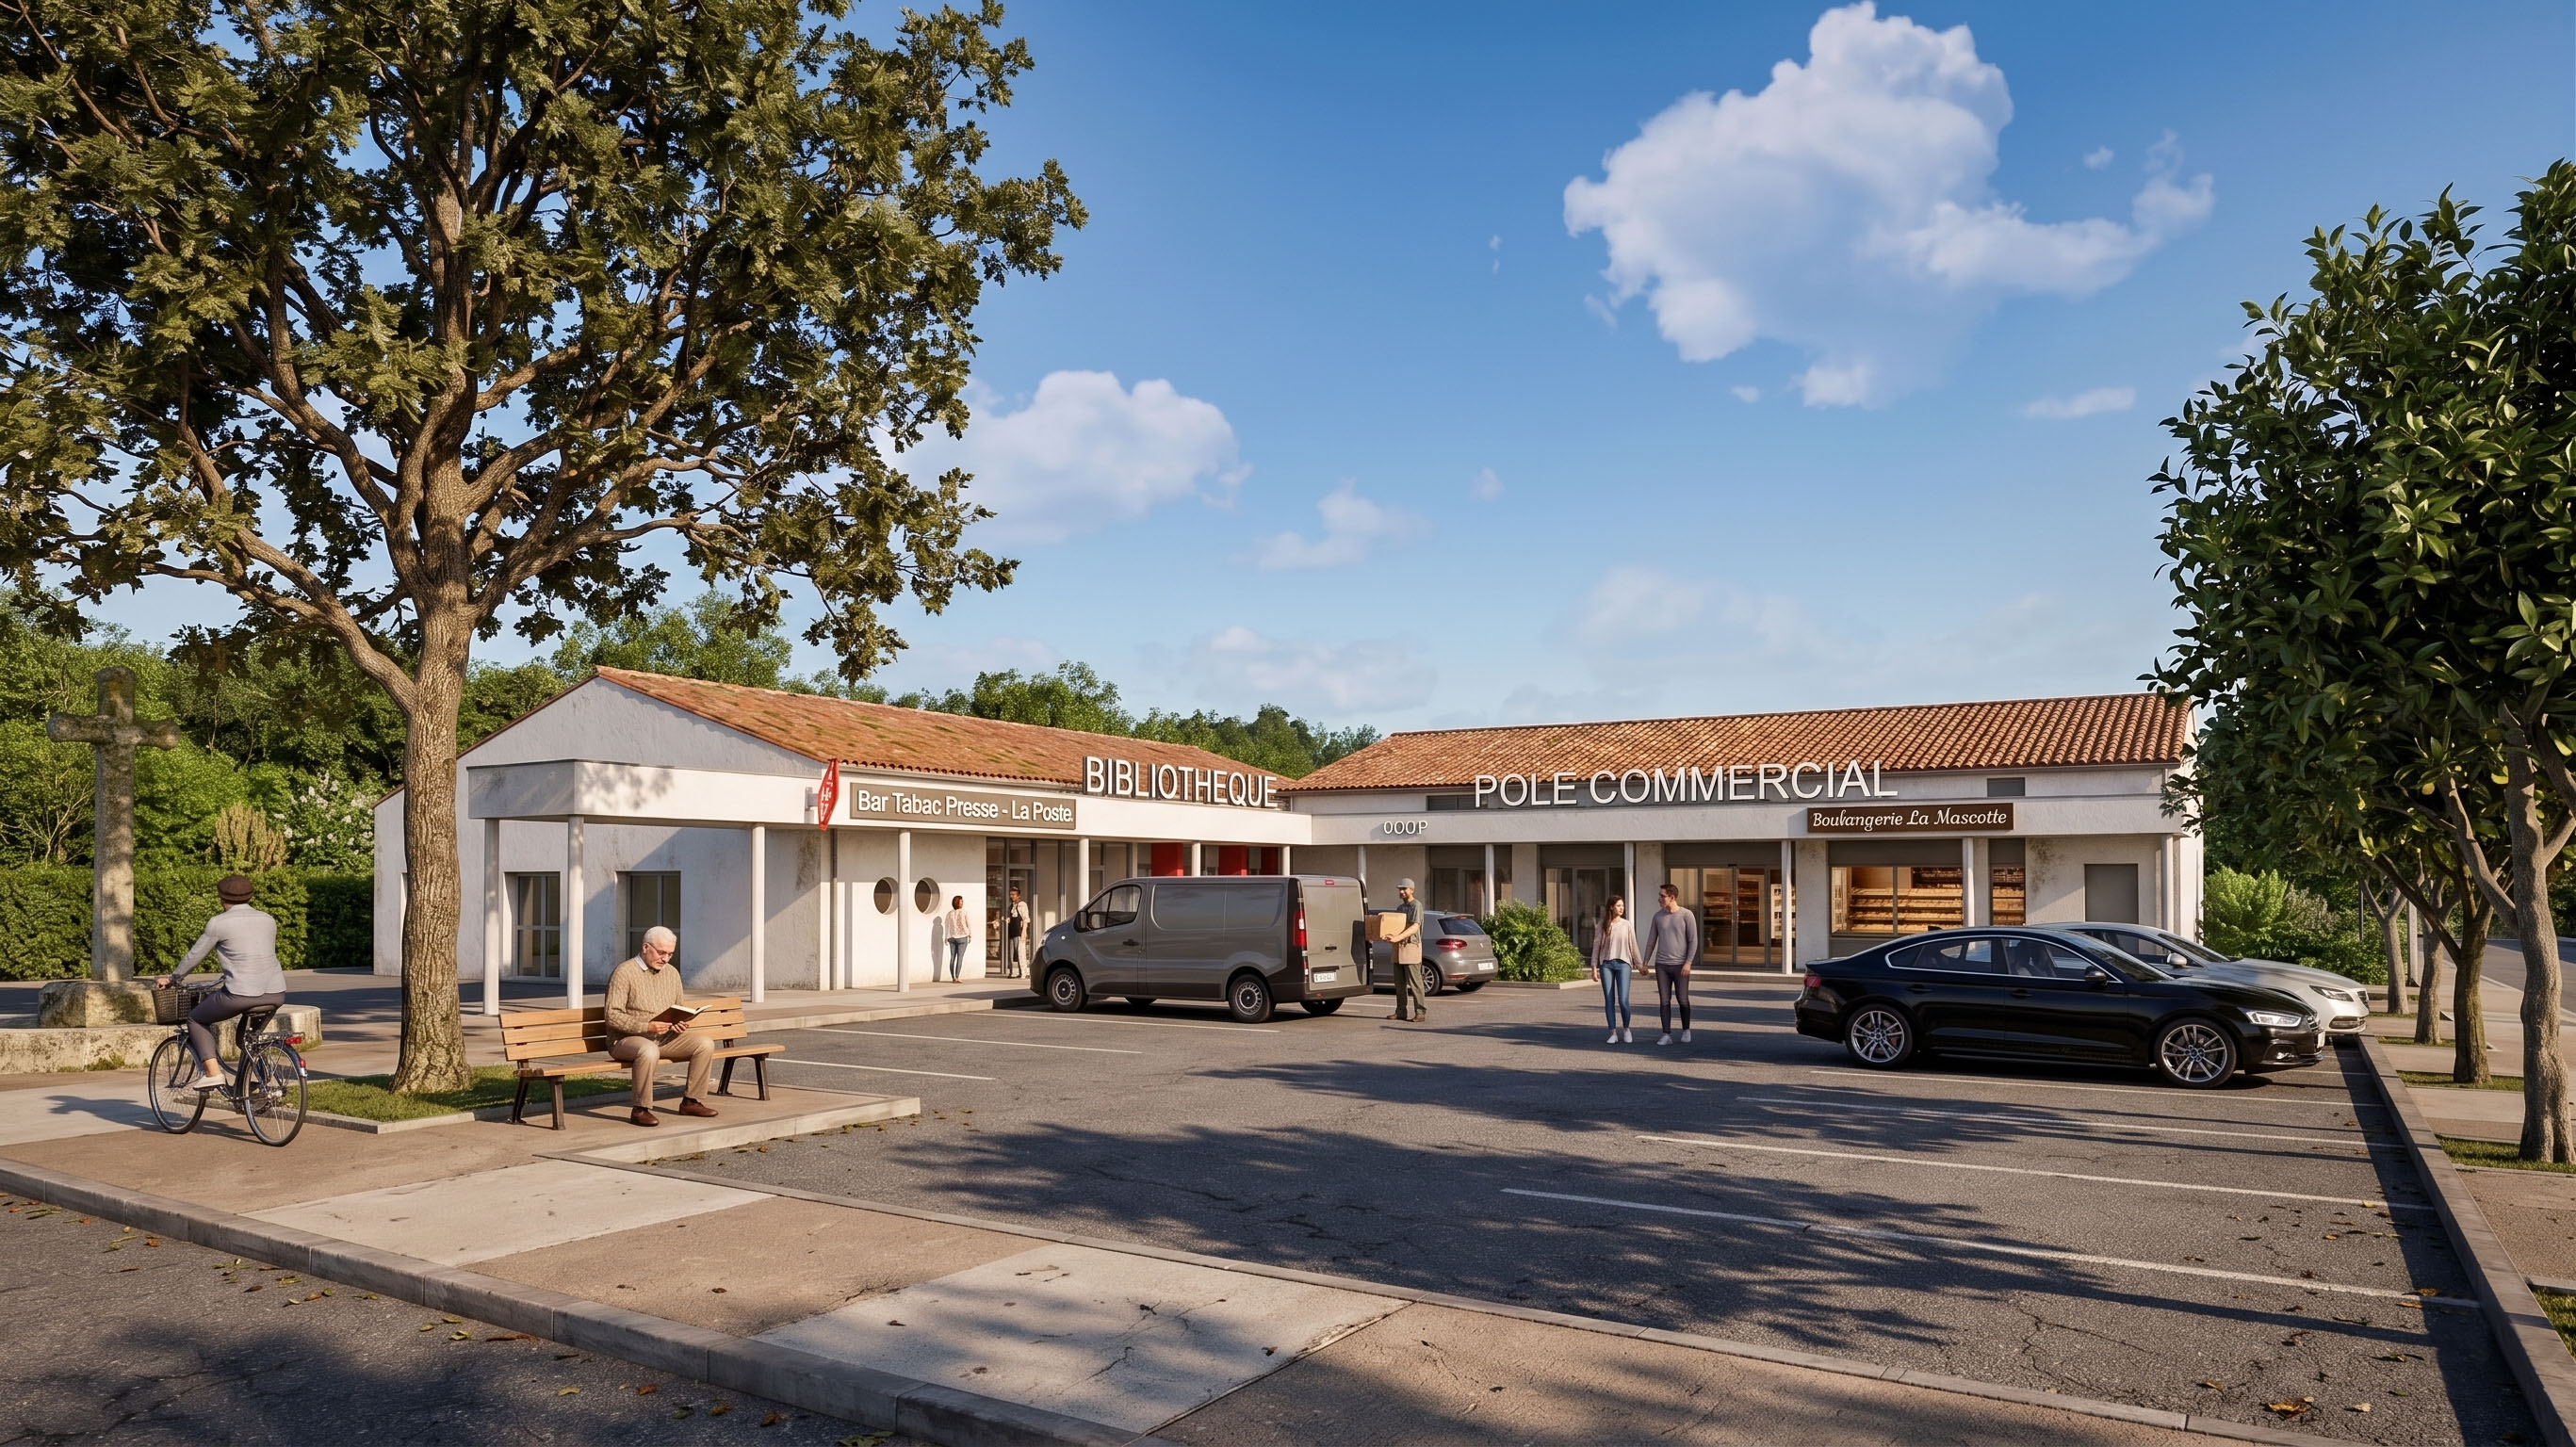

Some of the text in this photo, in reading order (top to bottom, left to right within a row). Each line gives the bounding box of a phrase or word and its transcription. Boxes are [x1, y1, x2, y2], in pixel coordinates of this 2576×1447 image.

[1084, 756, 1279, 808] BIBLIOTHEQUE
[1475, 759, 1899, 808] POLE COMMERCIAL
[857, 789, 889, 812] Bar
[892, 792, 942, 815] Tabac
[945, 796, 999, 819] Presse
[1011, 800, 1030, 821] La
[1813, 807, 2007, 831] Boulangerie La Mascotte
